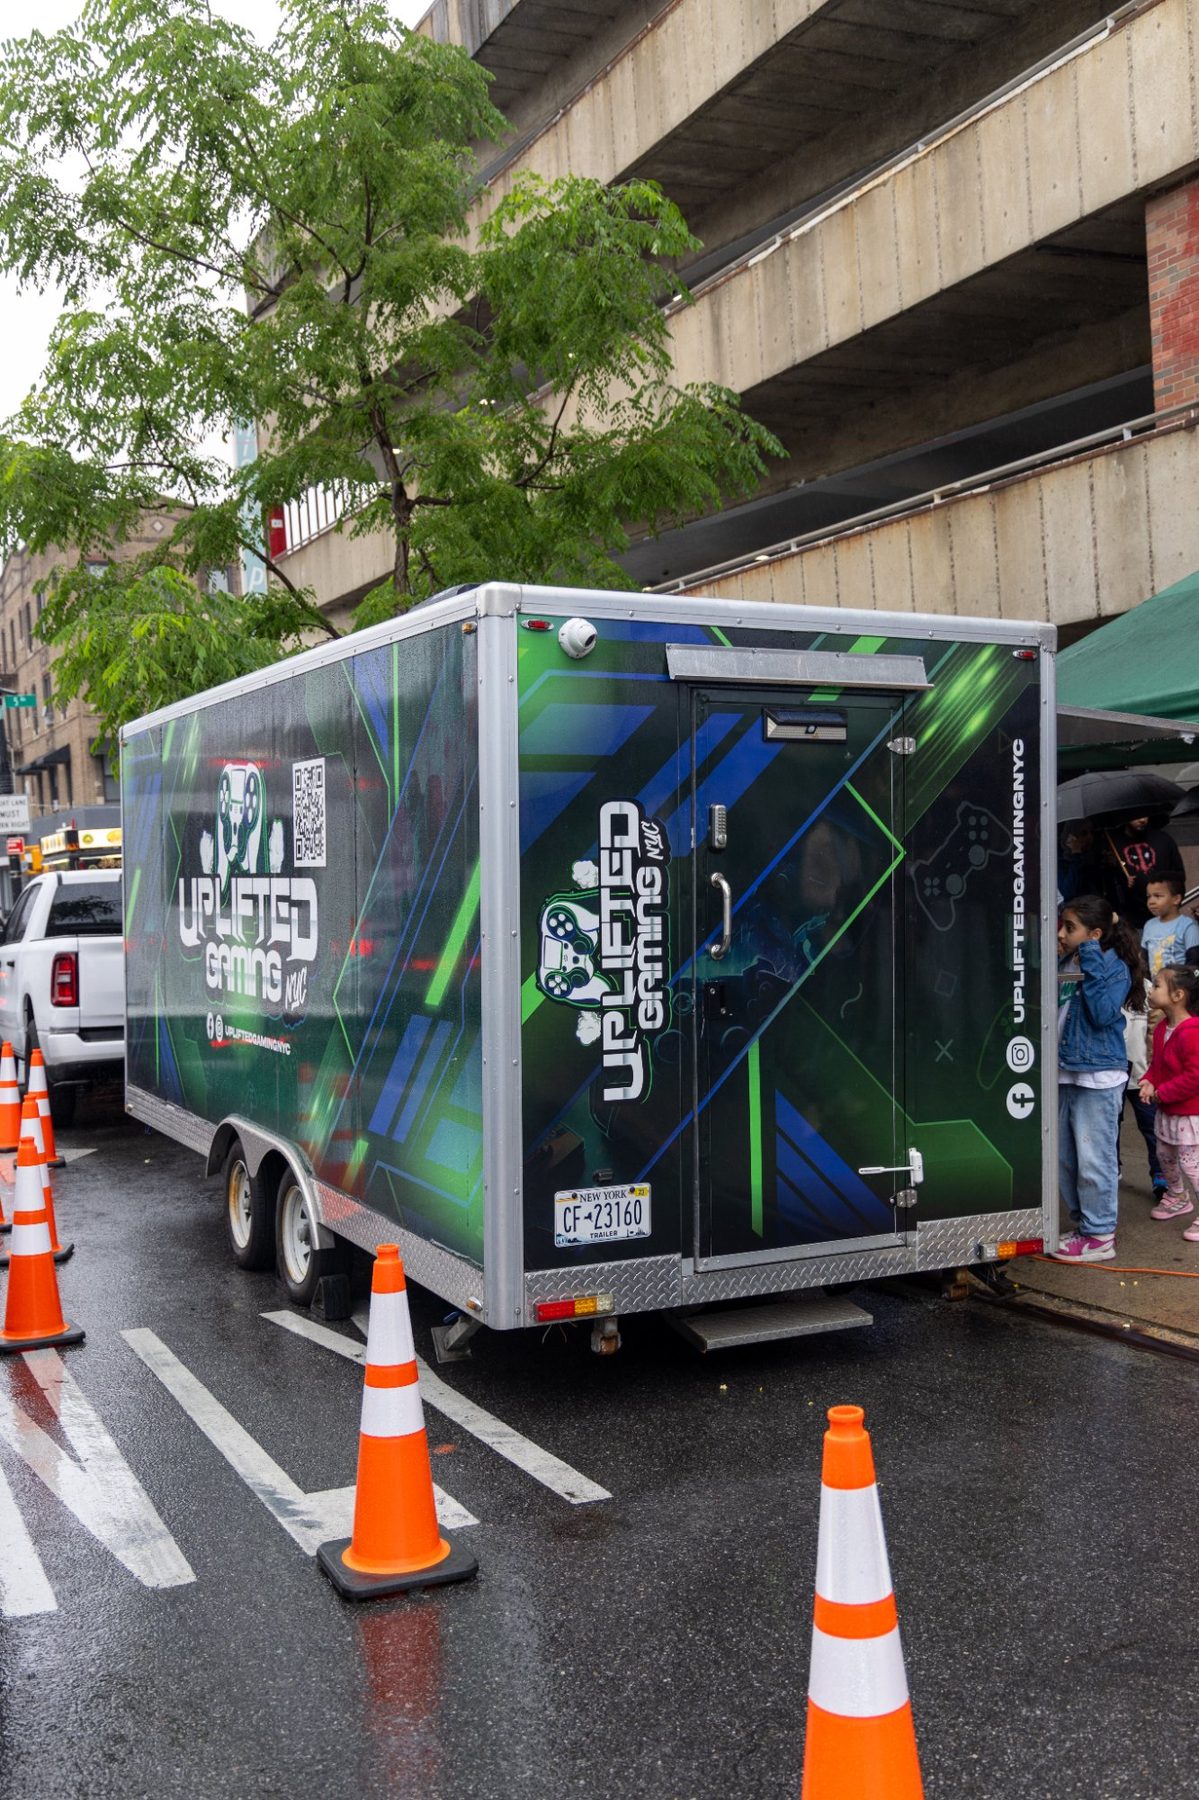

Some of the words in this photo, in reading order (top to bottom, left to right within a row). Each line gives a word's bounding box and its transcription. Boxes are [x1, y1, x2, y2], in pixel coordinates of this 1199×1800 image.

[641, 820, 664, 861] NYC
[1013, 738, 1025, 1023] UPLIFTEDGAMINGNYC
[179, 877, 318, 961] UPLIFTED
[600, 801, 643, 1101] UPLIFTED
[636, 866, 664, 1030] GAMING
[206, 941, 281, 1002] GAMING
[285, 966, 307, 1011] NYC
[225, 1025, 291, 1055] UPLIFTEDGAMINGNYC
[579, 1193, 601, 1203] NEW
[603, 1189, 628, 1200] YORK
[594, 1199, 642, 1230] 23160
[590, 1230, 618, 1239] TRAILER
